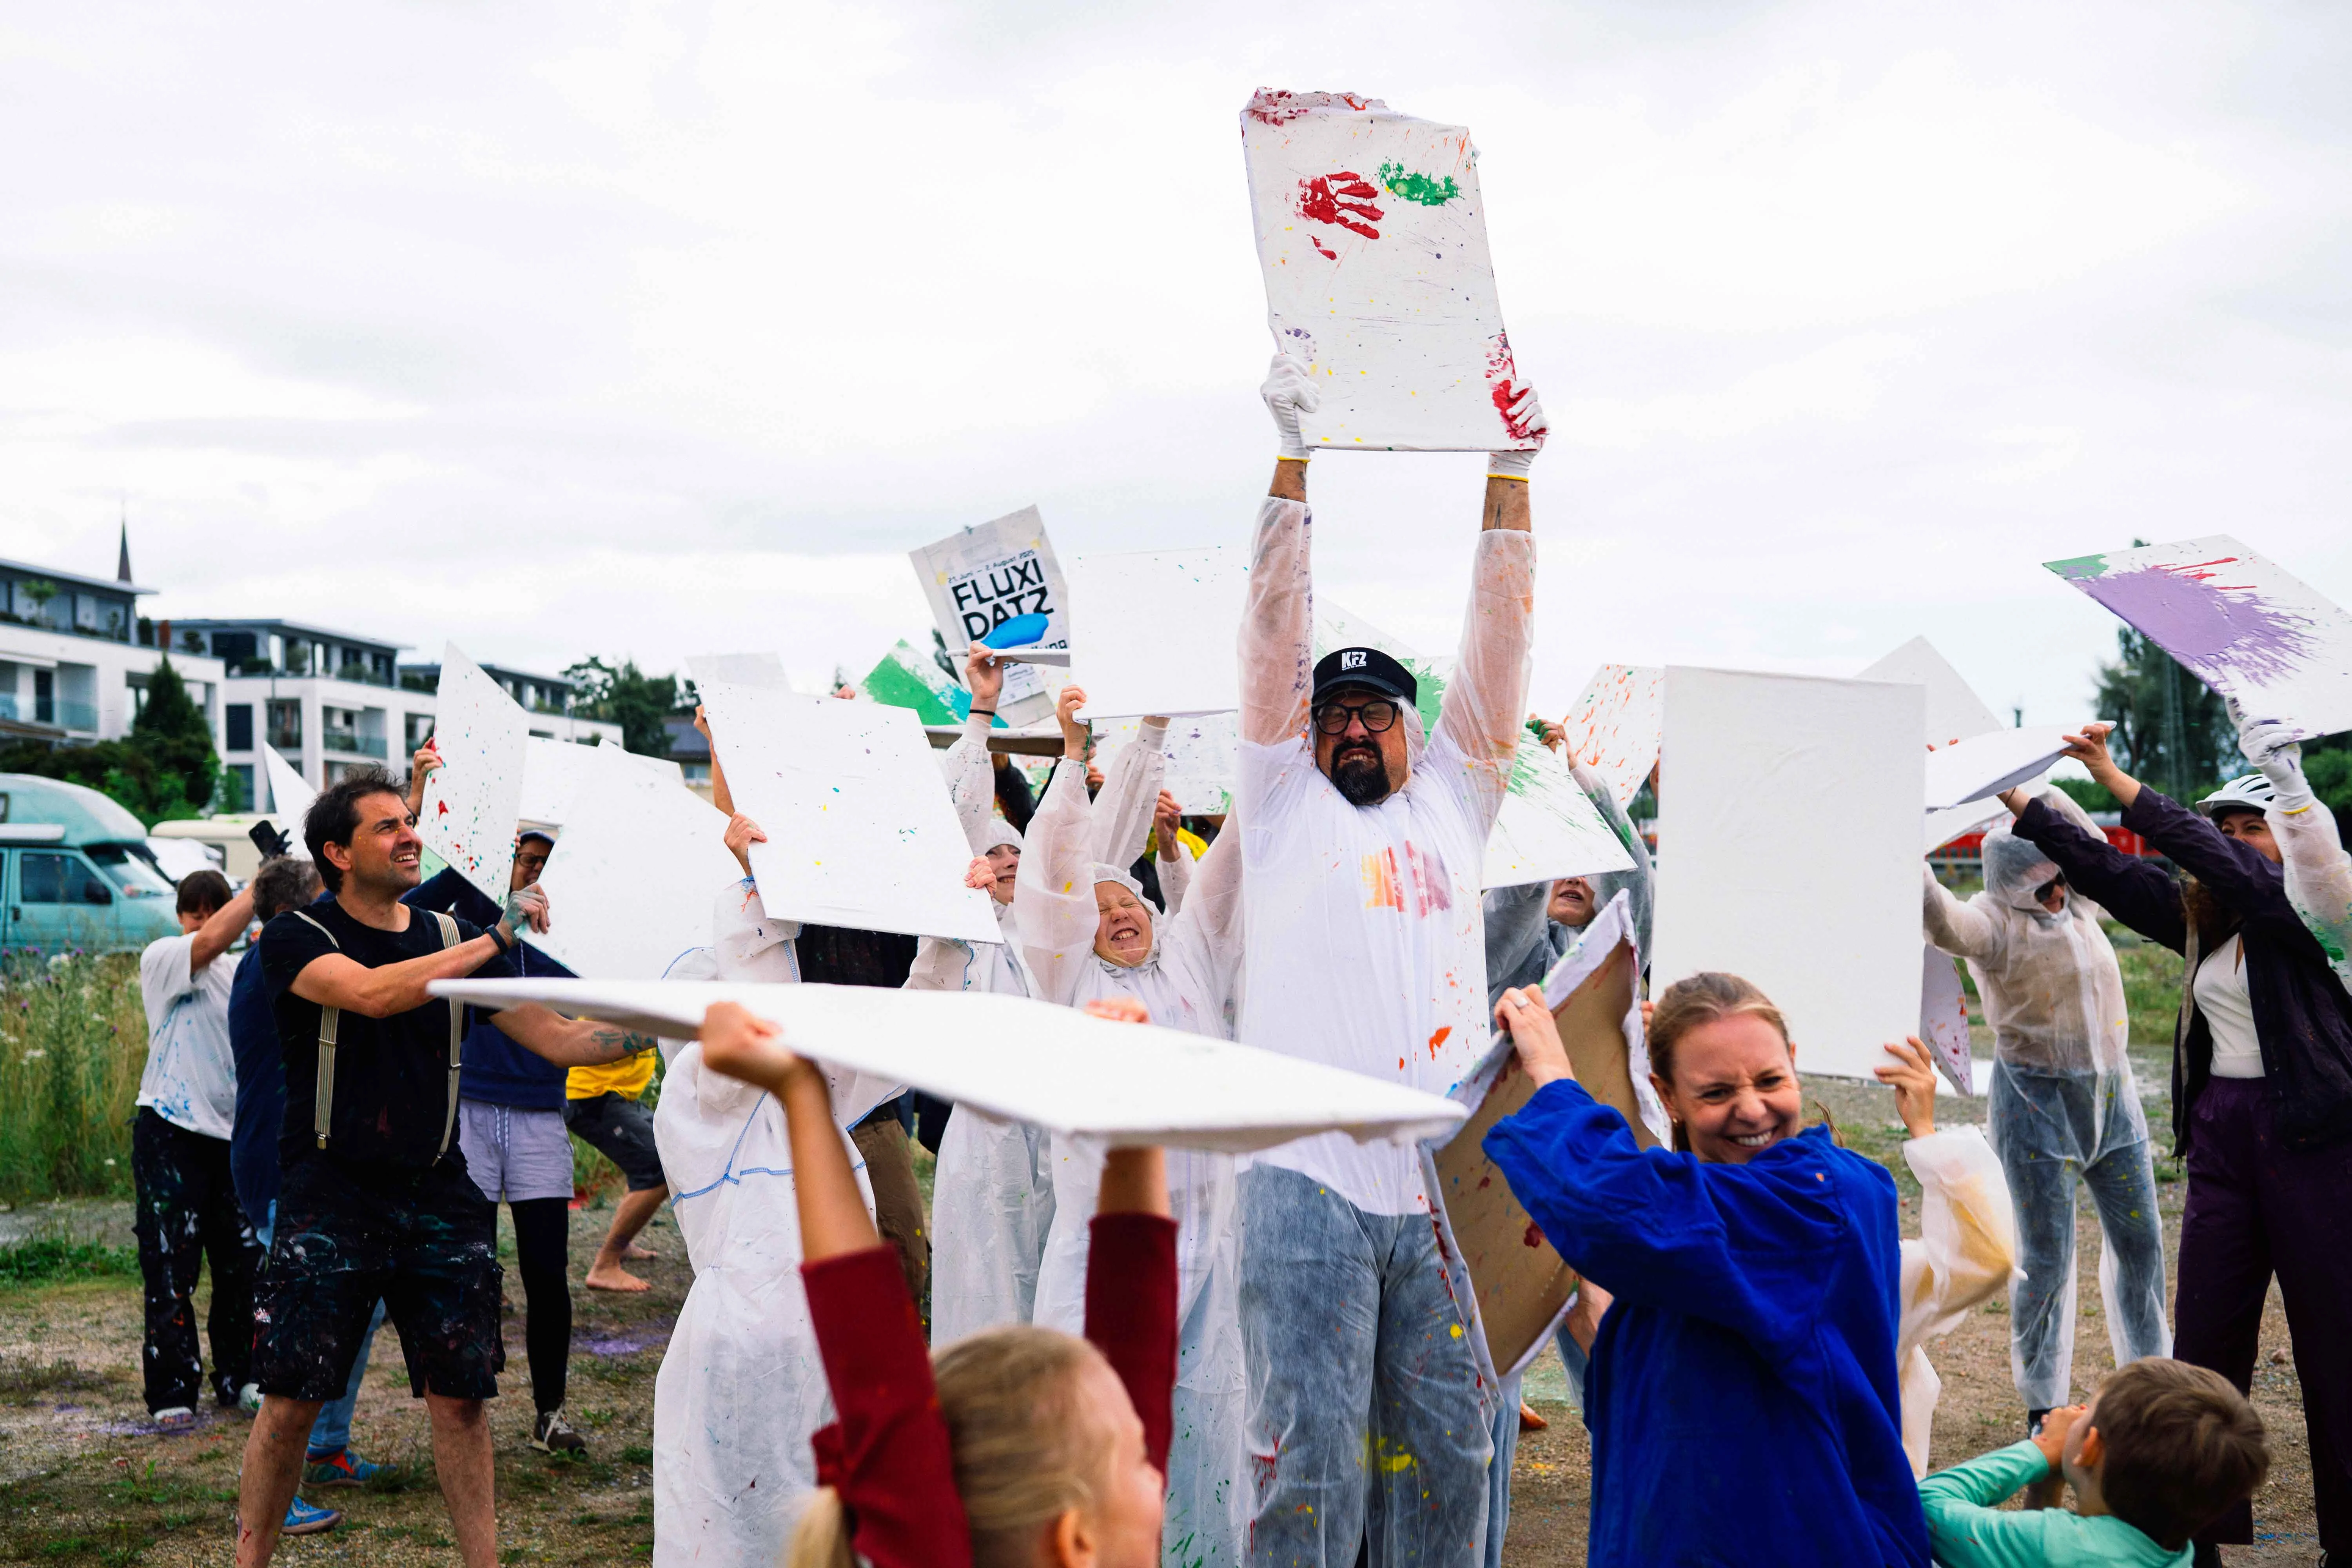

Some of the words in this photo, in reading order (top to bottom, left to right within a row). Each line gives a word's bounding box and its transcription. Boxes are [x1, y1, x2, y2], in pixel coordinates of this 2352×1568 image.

[993, 556, 1016, 567] August
[952, 558, 1044, 611] FLUXI
[1341, 652, 1367, 669] KFZ
